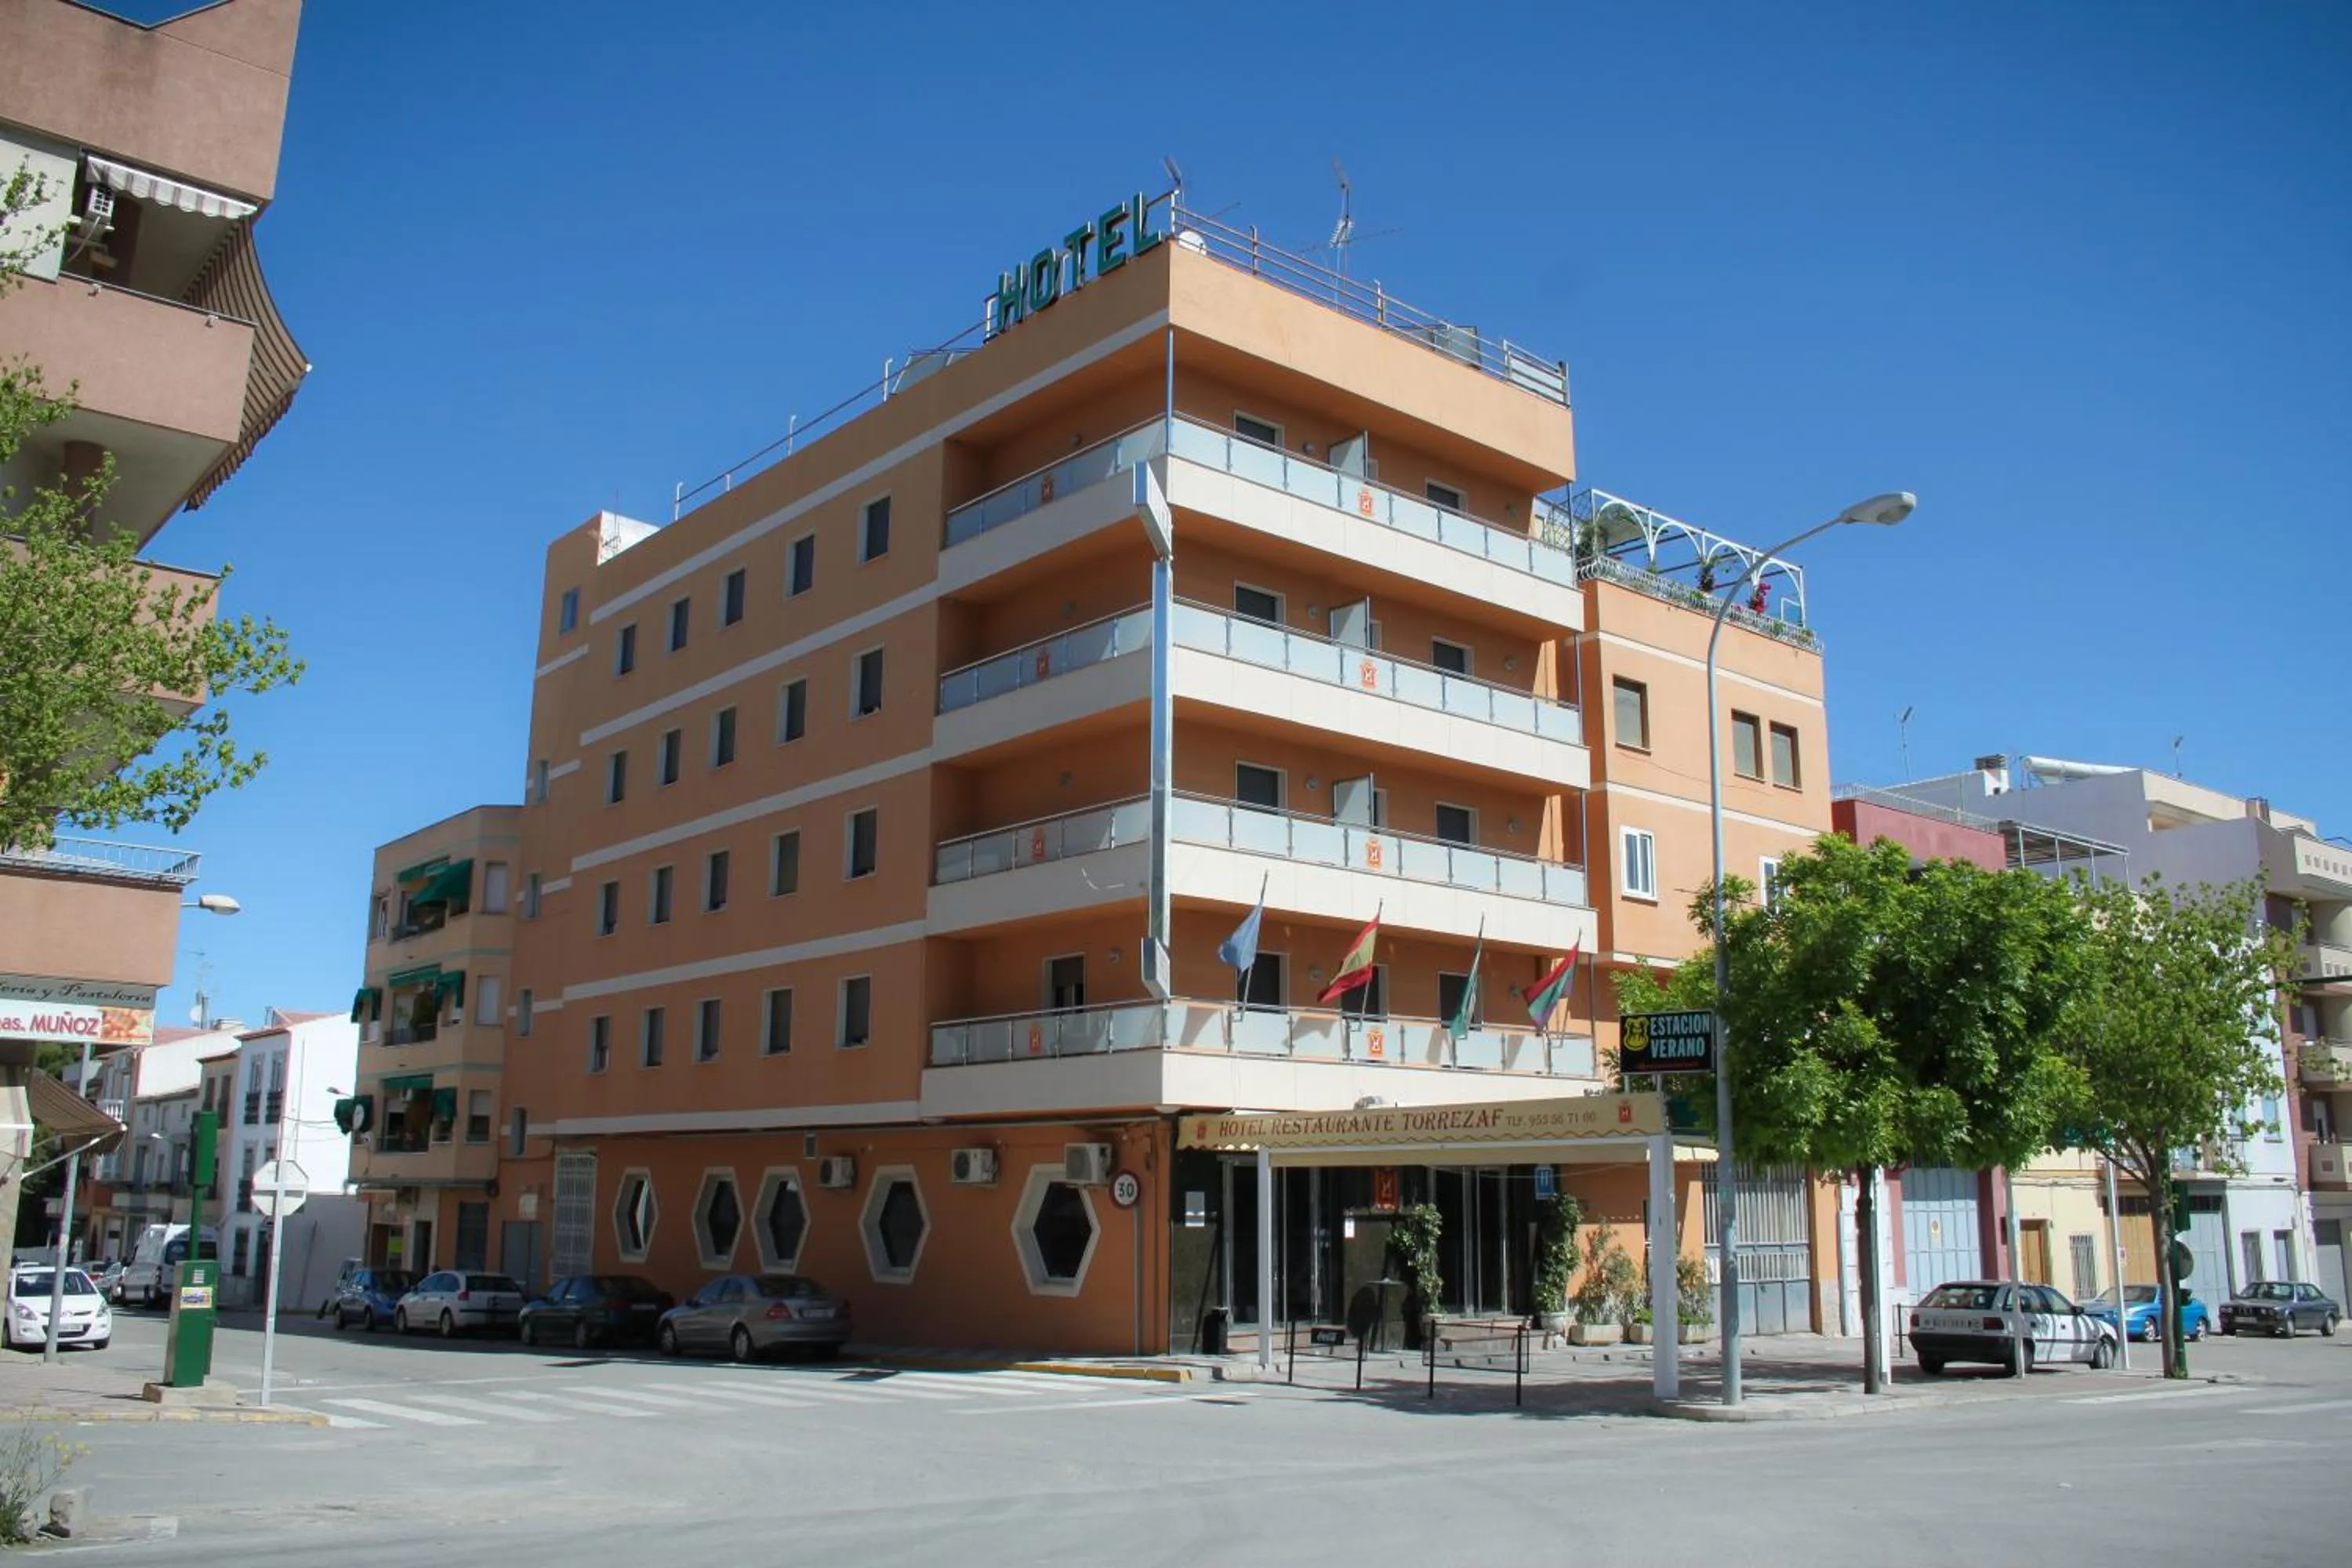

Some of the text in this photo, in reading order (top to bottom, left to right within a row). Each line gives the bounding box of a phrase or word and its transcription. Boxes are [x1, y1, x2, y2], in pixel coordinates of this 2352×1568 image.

[997, 191, 1162, 332] HOTEL
[35, 989, 54, 1001] y
[0, 1011, 100, 1035] as. MUÑOZ
[1650, 1014, 1710, 1036] ESTACION
[1650, 1036, 1705, 1058] VERANO
[1219, 1118, 1266, 1136] HOTEL
[1270, 1113, 1395, 1135] RESTAURANTE
[1403, 1108, 1504, 1131] TORREZAF
[1567, 1112, 1579, 1124] 71
[1118, 1182, 1134, 1198] 30
